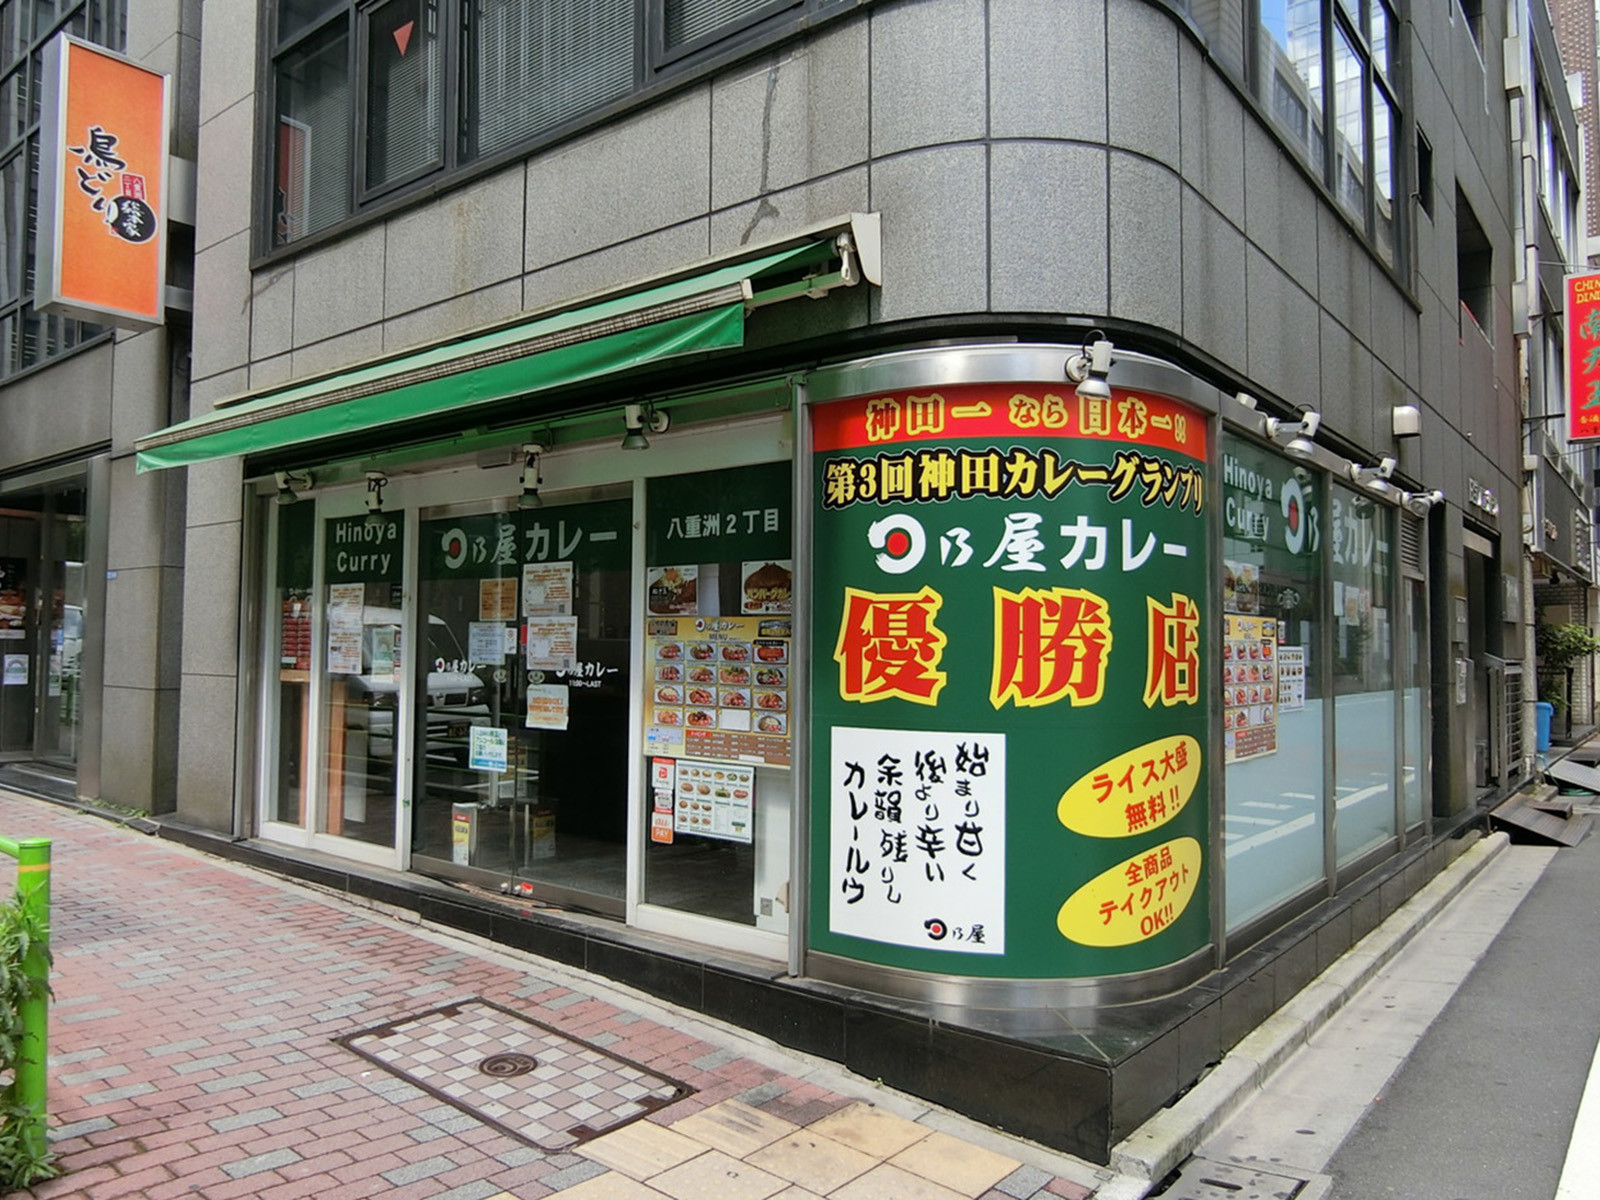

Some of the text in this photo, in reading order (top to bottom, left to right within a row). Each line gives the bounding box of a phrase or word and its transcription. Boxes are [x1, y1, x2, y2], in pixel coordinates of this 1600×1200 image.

[825, 449, 1203, 515] 第3回神田カレーグランプリ
[1223, 454, 1273, 500] Hinoya
[336, 522, 397, 544] Hinoya
[1226, 497, 1270, 541] Curry
[336, 551, 391, 575] Curry
[834, 585, 1200, 709] 優勝店
[1091, 741, 1189, 804] ライス大盛
[842, 761, 870, 904] カレールウ
[874, 753, 908, 904] 余韻残りし
[914, 750, 946, 882] 後より辛い
[955, 742, 989, 881] 始まり甘く
[1124, 785, 1180, 833] 無料!!
[1098, 863, 1189, 925] テイクアウト
[1125, 846, 1173, 887] 全商品
[1140, 903, 1174, 936] OK!!
